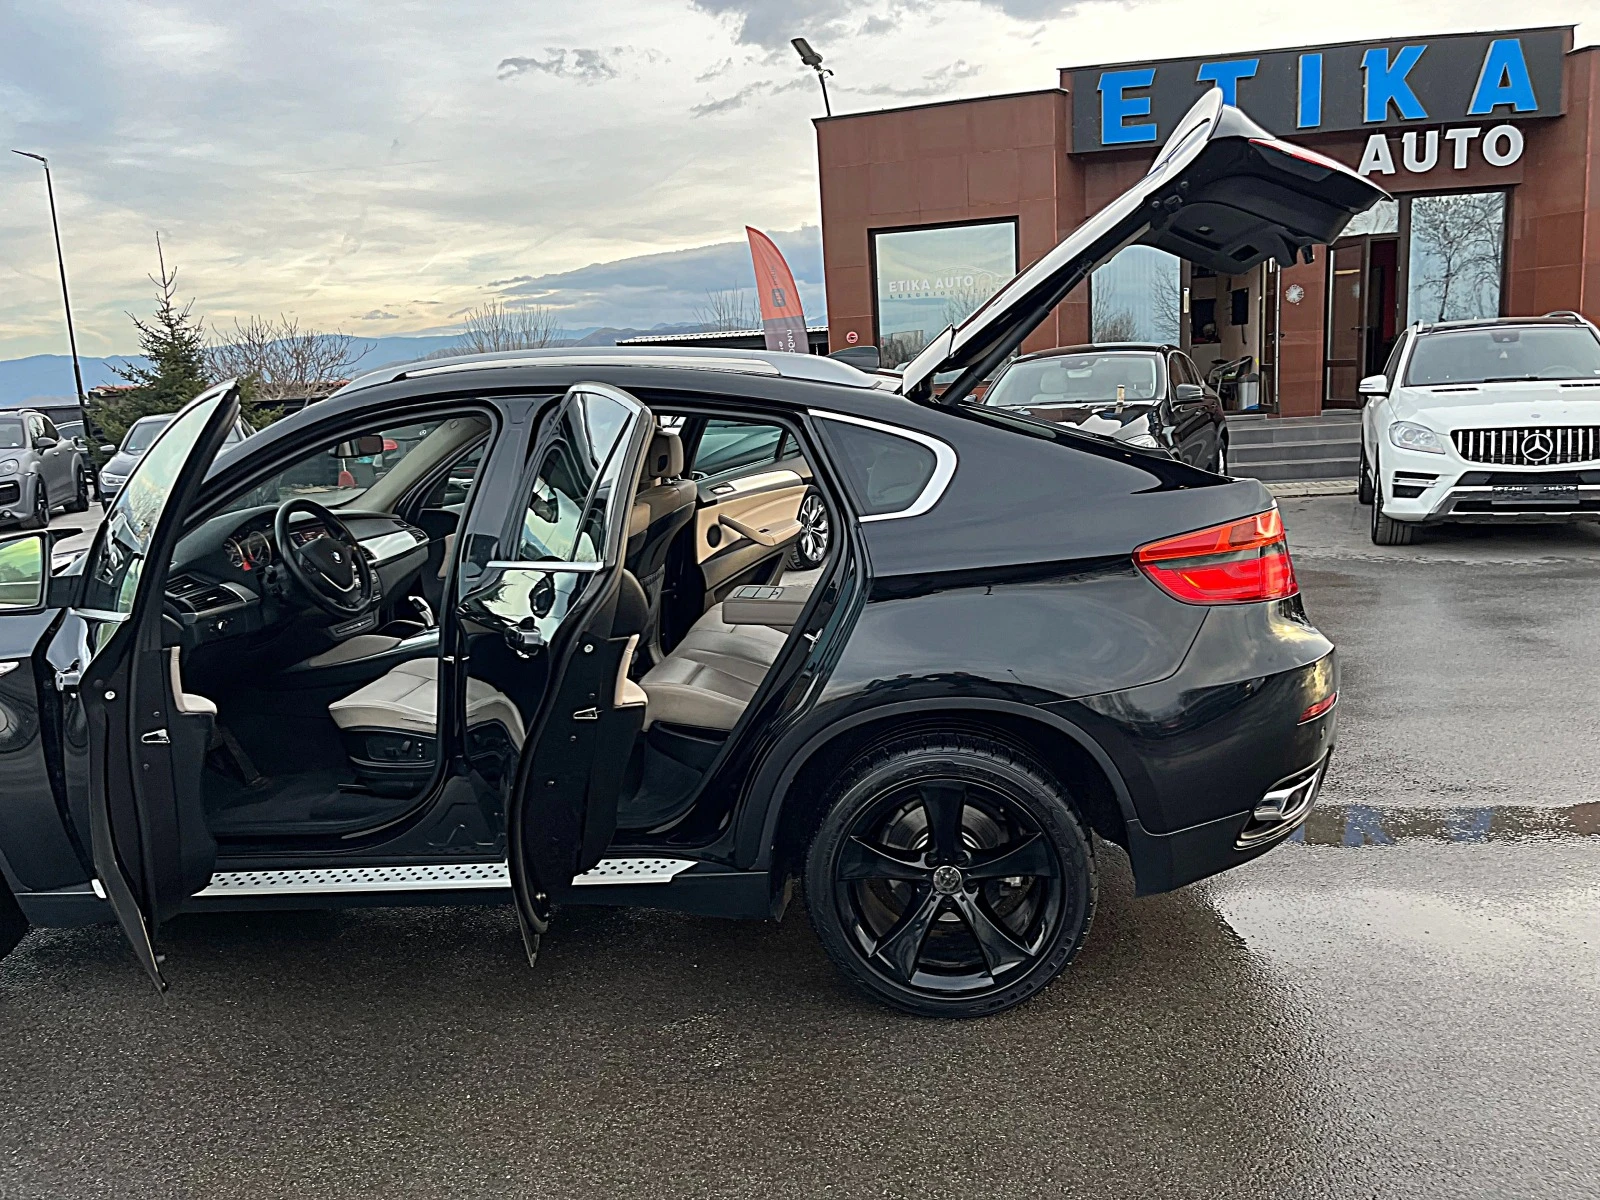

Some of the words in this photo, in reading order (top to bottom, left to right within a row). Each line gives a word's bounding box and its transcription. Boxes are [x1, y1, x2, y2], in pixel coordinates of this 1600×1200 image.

[1097, 38, 1538, 145] ETIKA
[1357, 124, 1524, 176] AUTO
[888, 279, 931, 293] ETIKA
[935, 275, 974, 289] AUTO
